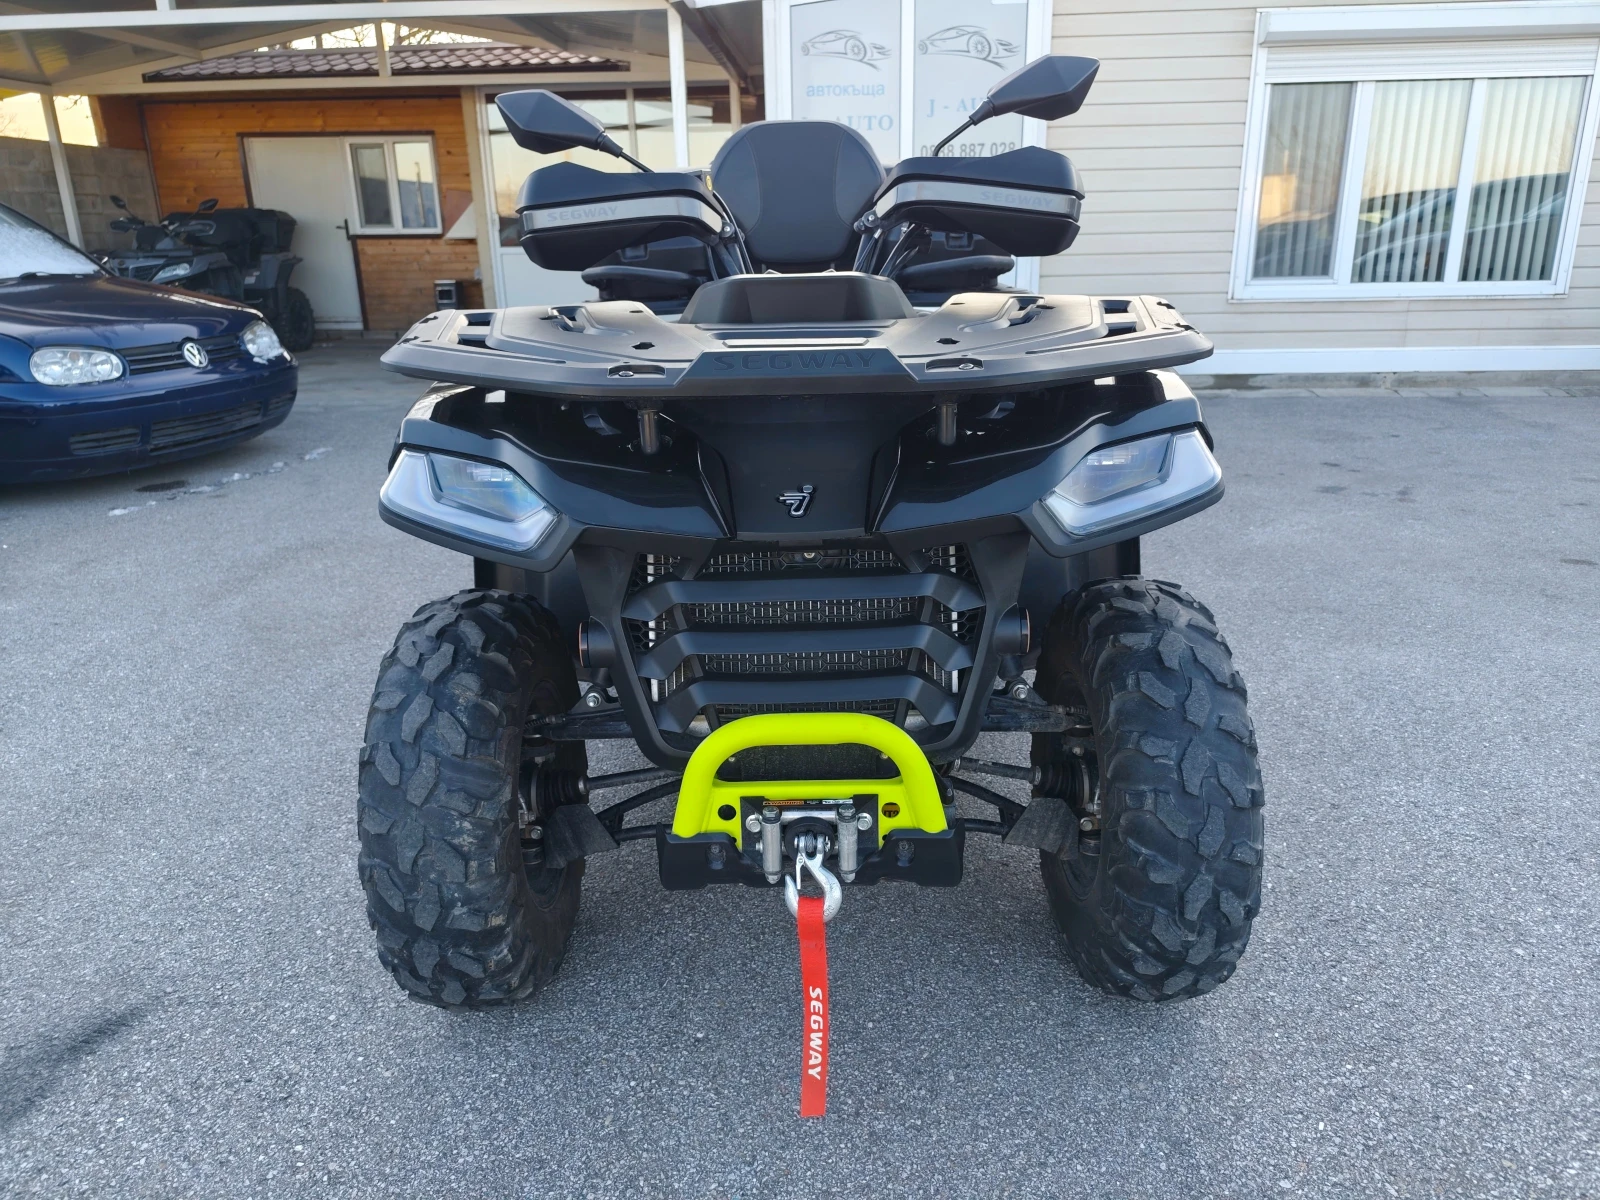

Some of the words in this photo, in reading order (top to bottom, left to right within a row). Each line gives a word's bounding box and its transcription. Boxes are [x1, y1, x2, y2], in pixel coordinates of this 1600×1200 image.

[806, 83, 885, 98] автокъща
[836, 114, 894, 131] UTO
[959, 143, 986, 158] 887
[980, 190, 1053, 208] SEGWAY
[547, 205, 618, 222] SEGWAY
[713, 351, 877, 371] SEGWAY
[808, 985, 823, 1081] SEGWAY
